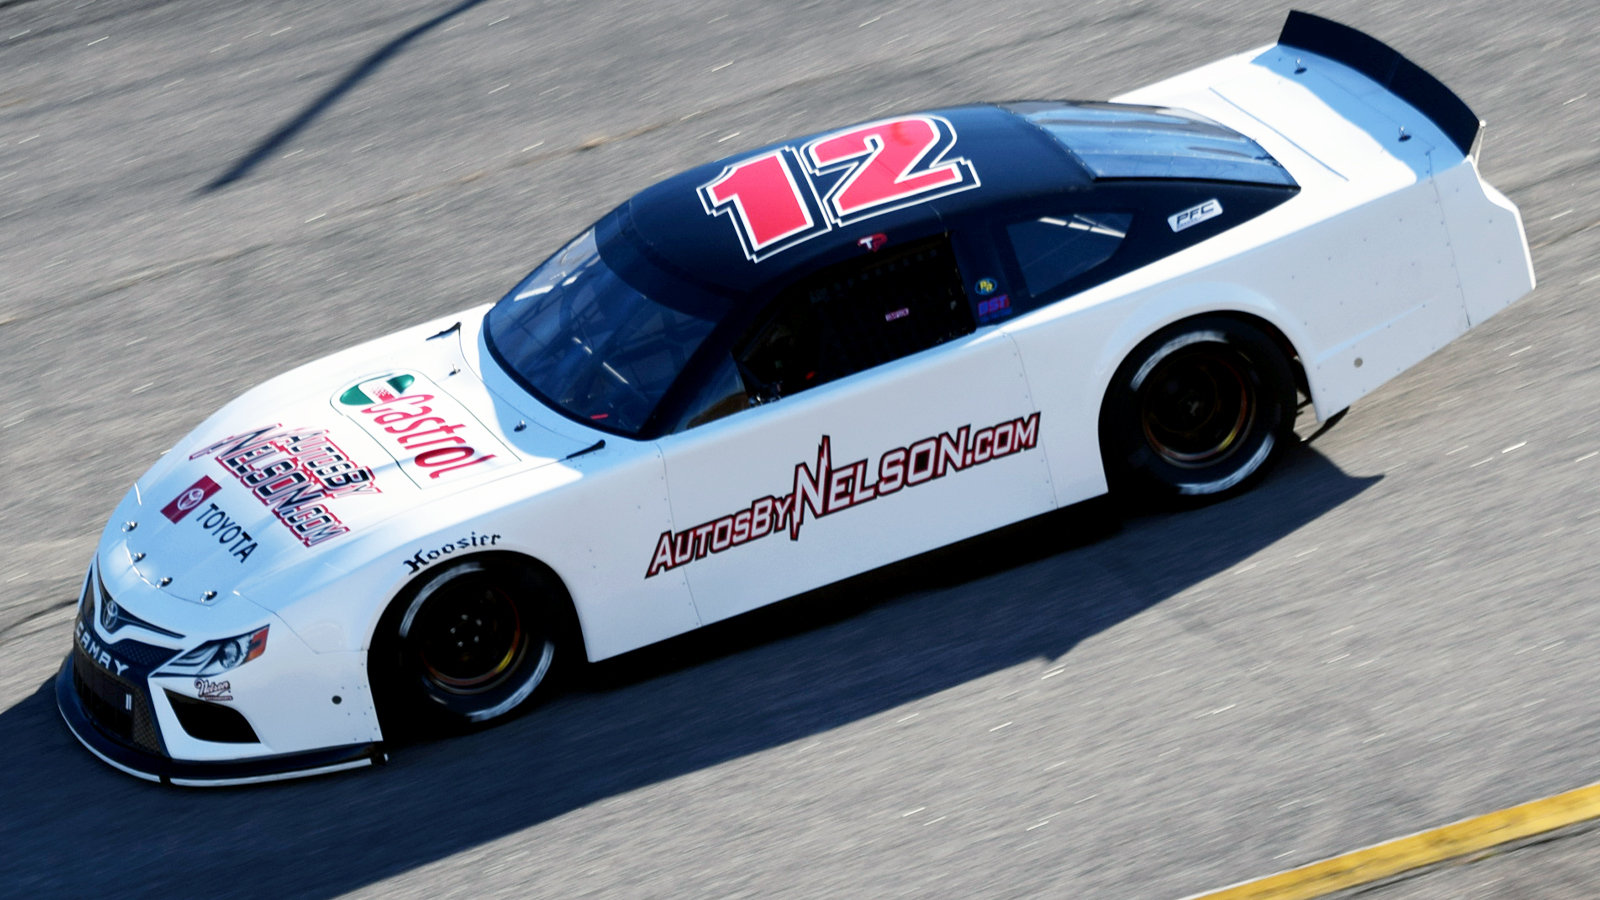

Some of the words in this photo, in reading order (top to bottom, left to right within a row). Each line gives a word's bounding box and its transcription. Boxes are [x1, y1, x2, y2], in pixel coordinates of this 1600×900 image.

[697, 114, 981, 263] 12
[1176, 201, 1214, 226] PFC
[361, 394, 498, 479] Castrol
[196, 503, 259, 563] TOYOTA
[403, 531, 501, 576] Hoosier
[76, 621, 129, 676] CAMRY
